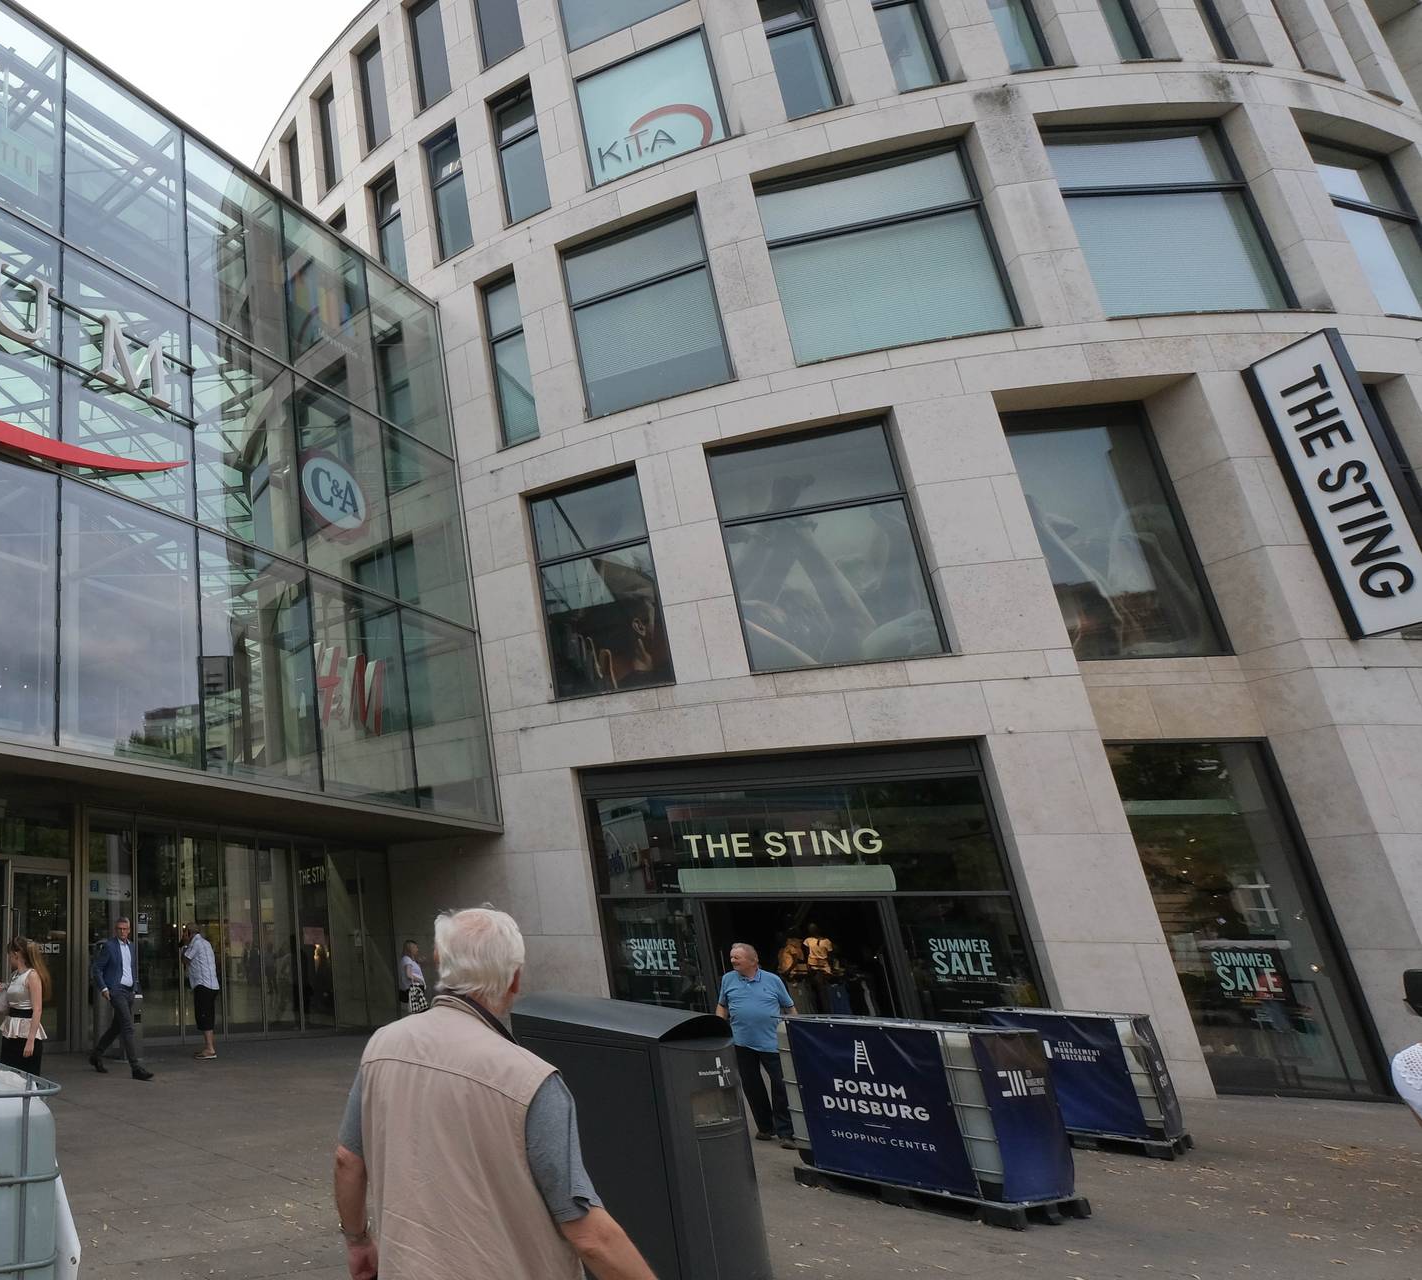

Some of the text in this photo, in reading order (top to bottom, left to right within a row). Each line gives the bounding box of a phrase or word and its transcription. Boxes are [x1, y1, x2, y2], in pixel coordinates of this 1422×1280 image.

[310, 466, 362, 520] C&A
[1281, 364, 1414, 599] THE STING
[683, 827, 883, 860] THE STING
[629, 938, 676, 951] SUMMER
[928, 938, 991, 953] SUMMER
[632, 950, 681, 971] SALE
[932, 951, 997, 976] SALE
[1210, 951, 1275, 968] SUMMER
[1216, 965, 1283, 993] SALE
[833, 1077, 906, 1100] FORUM
[822, 1094, 931, 1122] DUISBURG
[831, 1129, 938, 1153] SHOPPING CENTER
